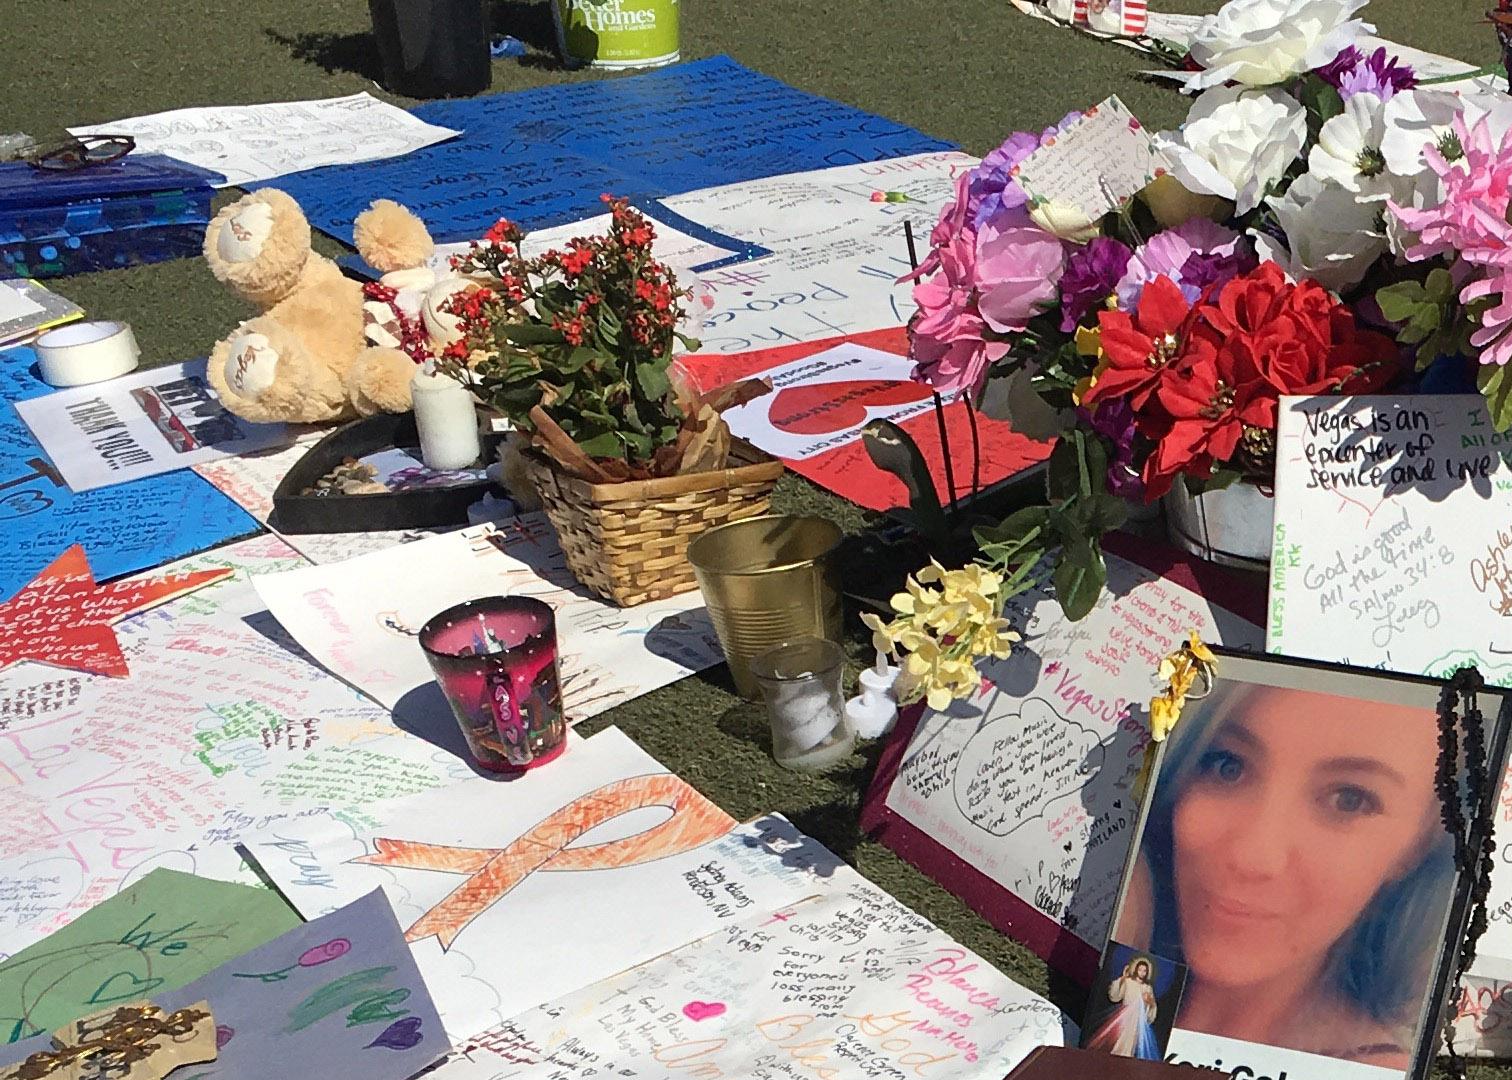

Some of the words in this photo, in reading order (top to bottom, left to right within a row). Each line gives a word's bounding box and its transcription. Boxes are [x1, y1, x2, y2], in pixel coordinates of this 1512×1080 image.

[582, 8, 655, 31] Homes
[65, 397, 128, 435] THANK
[1304, 410, 1364, 444] Vegas
[1372, 411, 1392, 430] is
[1396, 410, 1430, 432] an
[1305, 437, 1398, 466] epicenter
[1404, 435, 1435, 461] of
[1306, 464, 1384, 489] service
[1392, 454, 1434, 483] and
